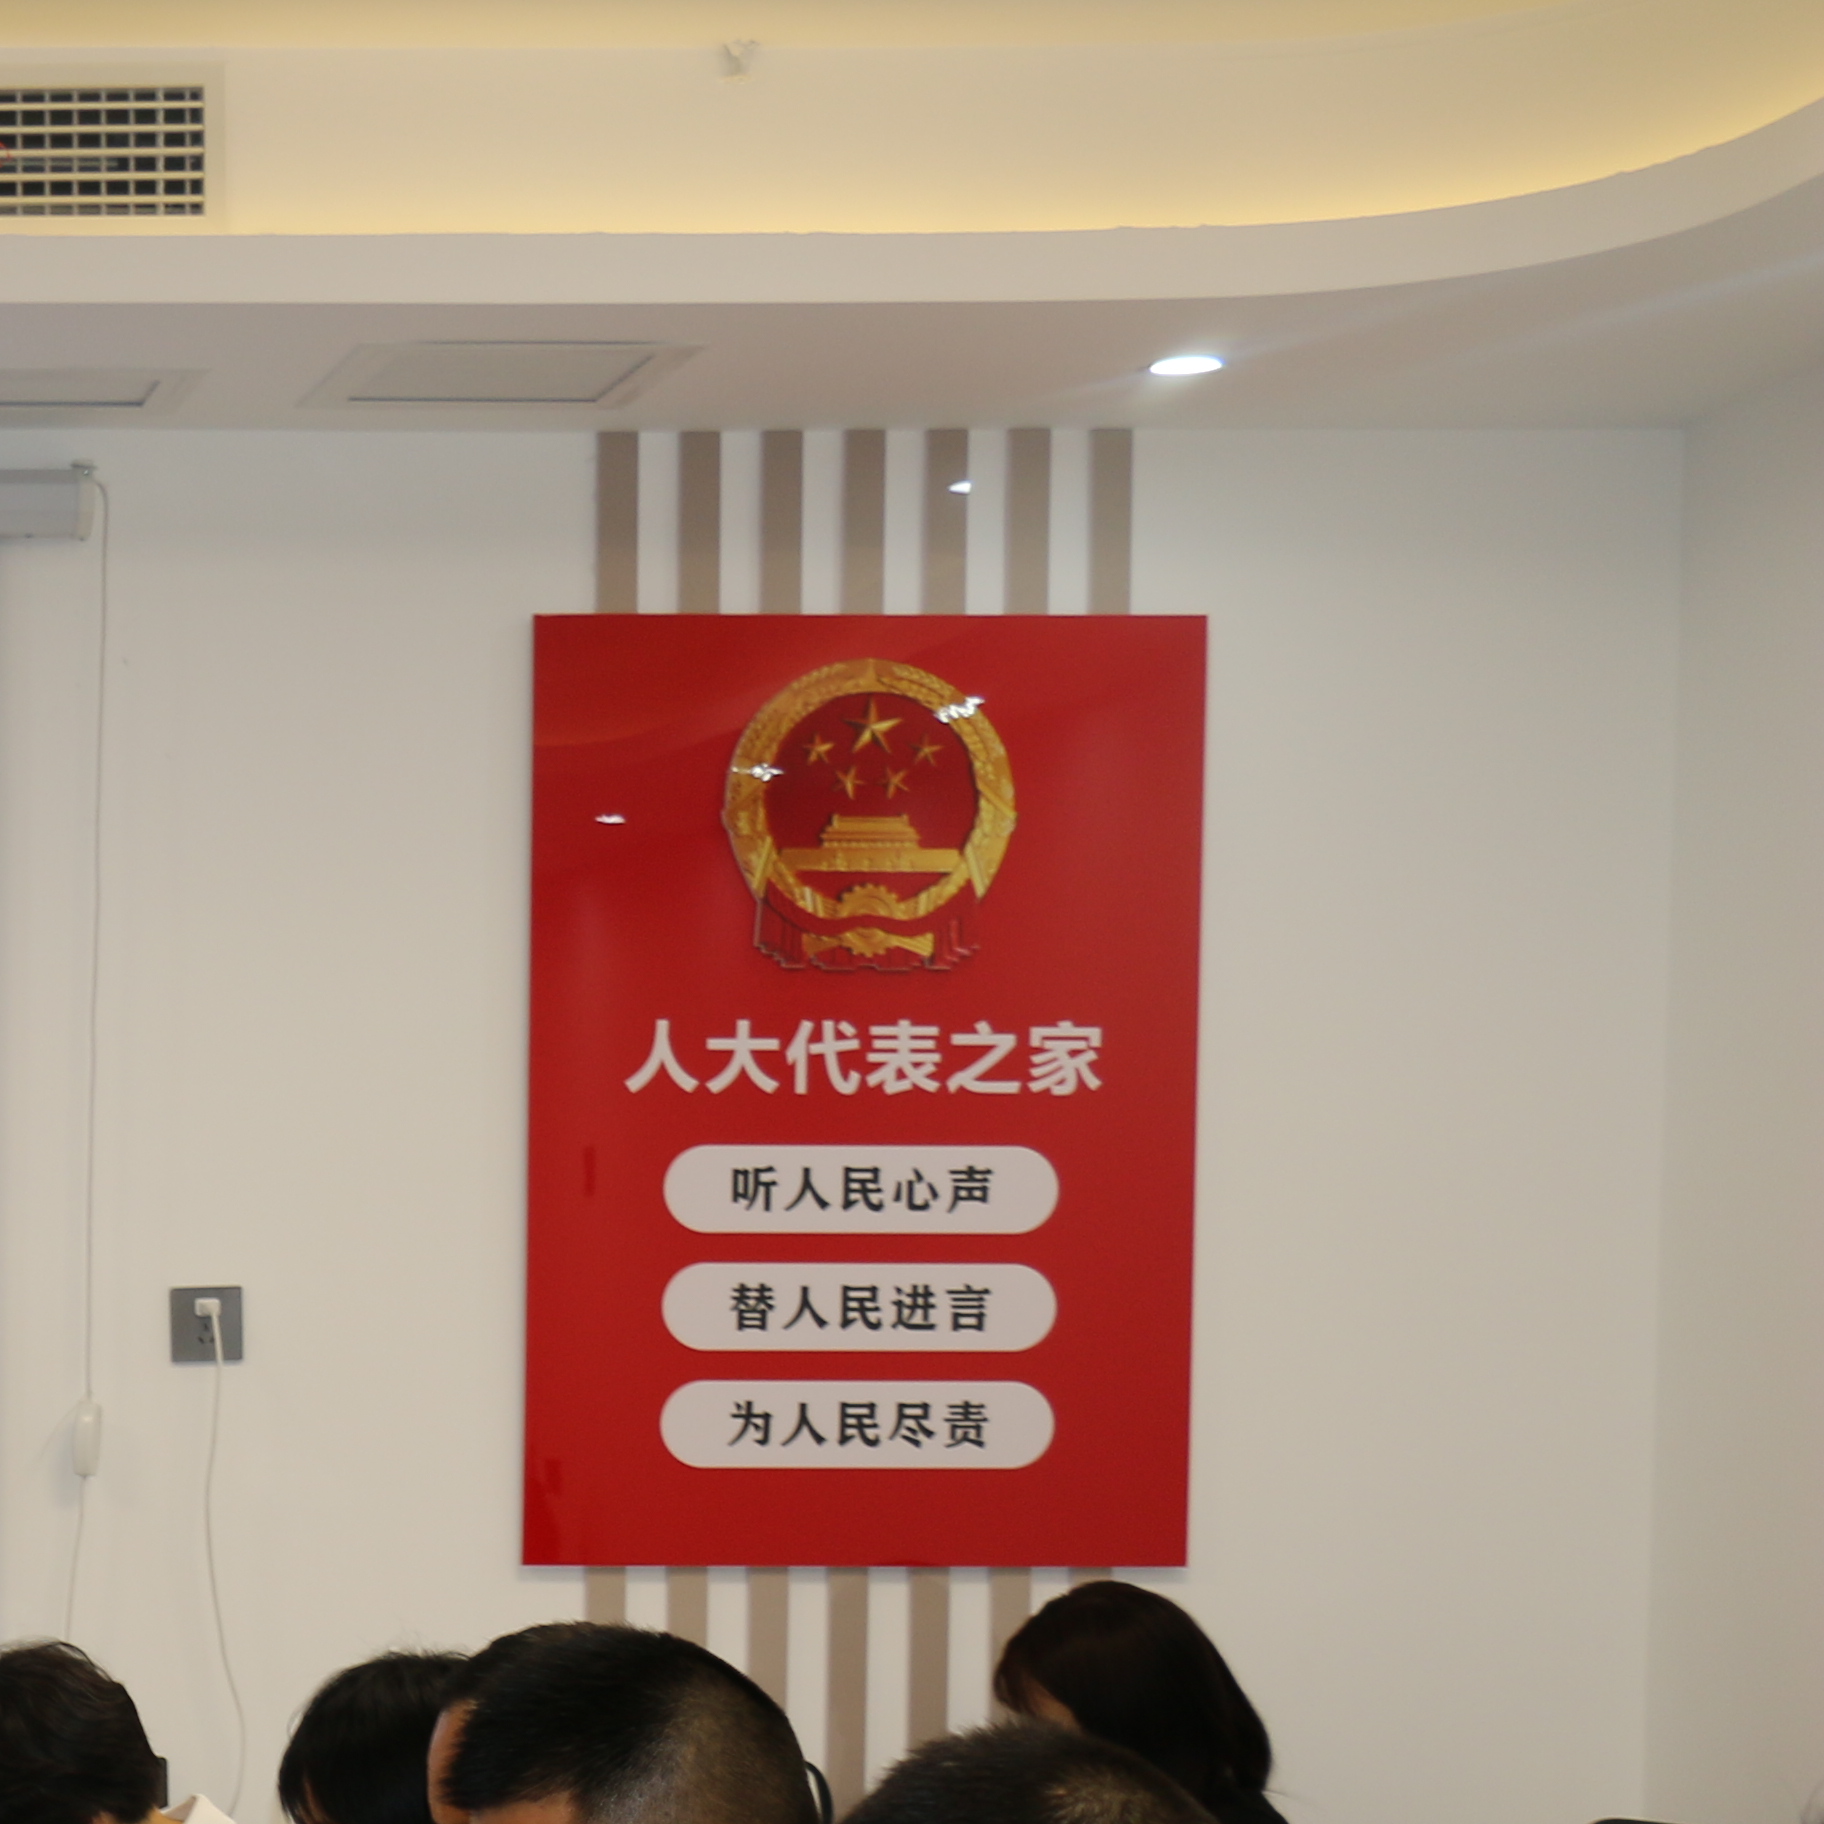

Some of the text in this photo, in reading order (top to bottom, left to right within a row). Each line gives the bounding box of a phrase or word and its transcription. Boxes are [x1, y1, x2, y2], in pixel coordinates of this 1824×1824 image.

[625, 1018, 1104, 1096] 人大代表之家
[730, 1165, 994, 1214] 听人民心声
[730, 1282, 993, 1333] 替人民进言
[728, 1400, 990, 1450] 为人民尽责
